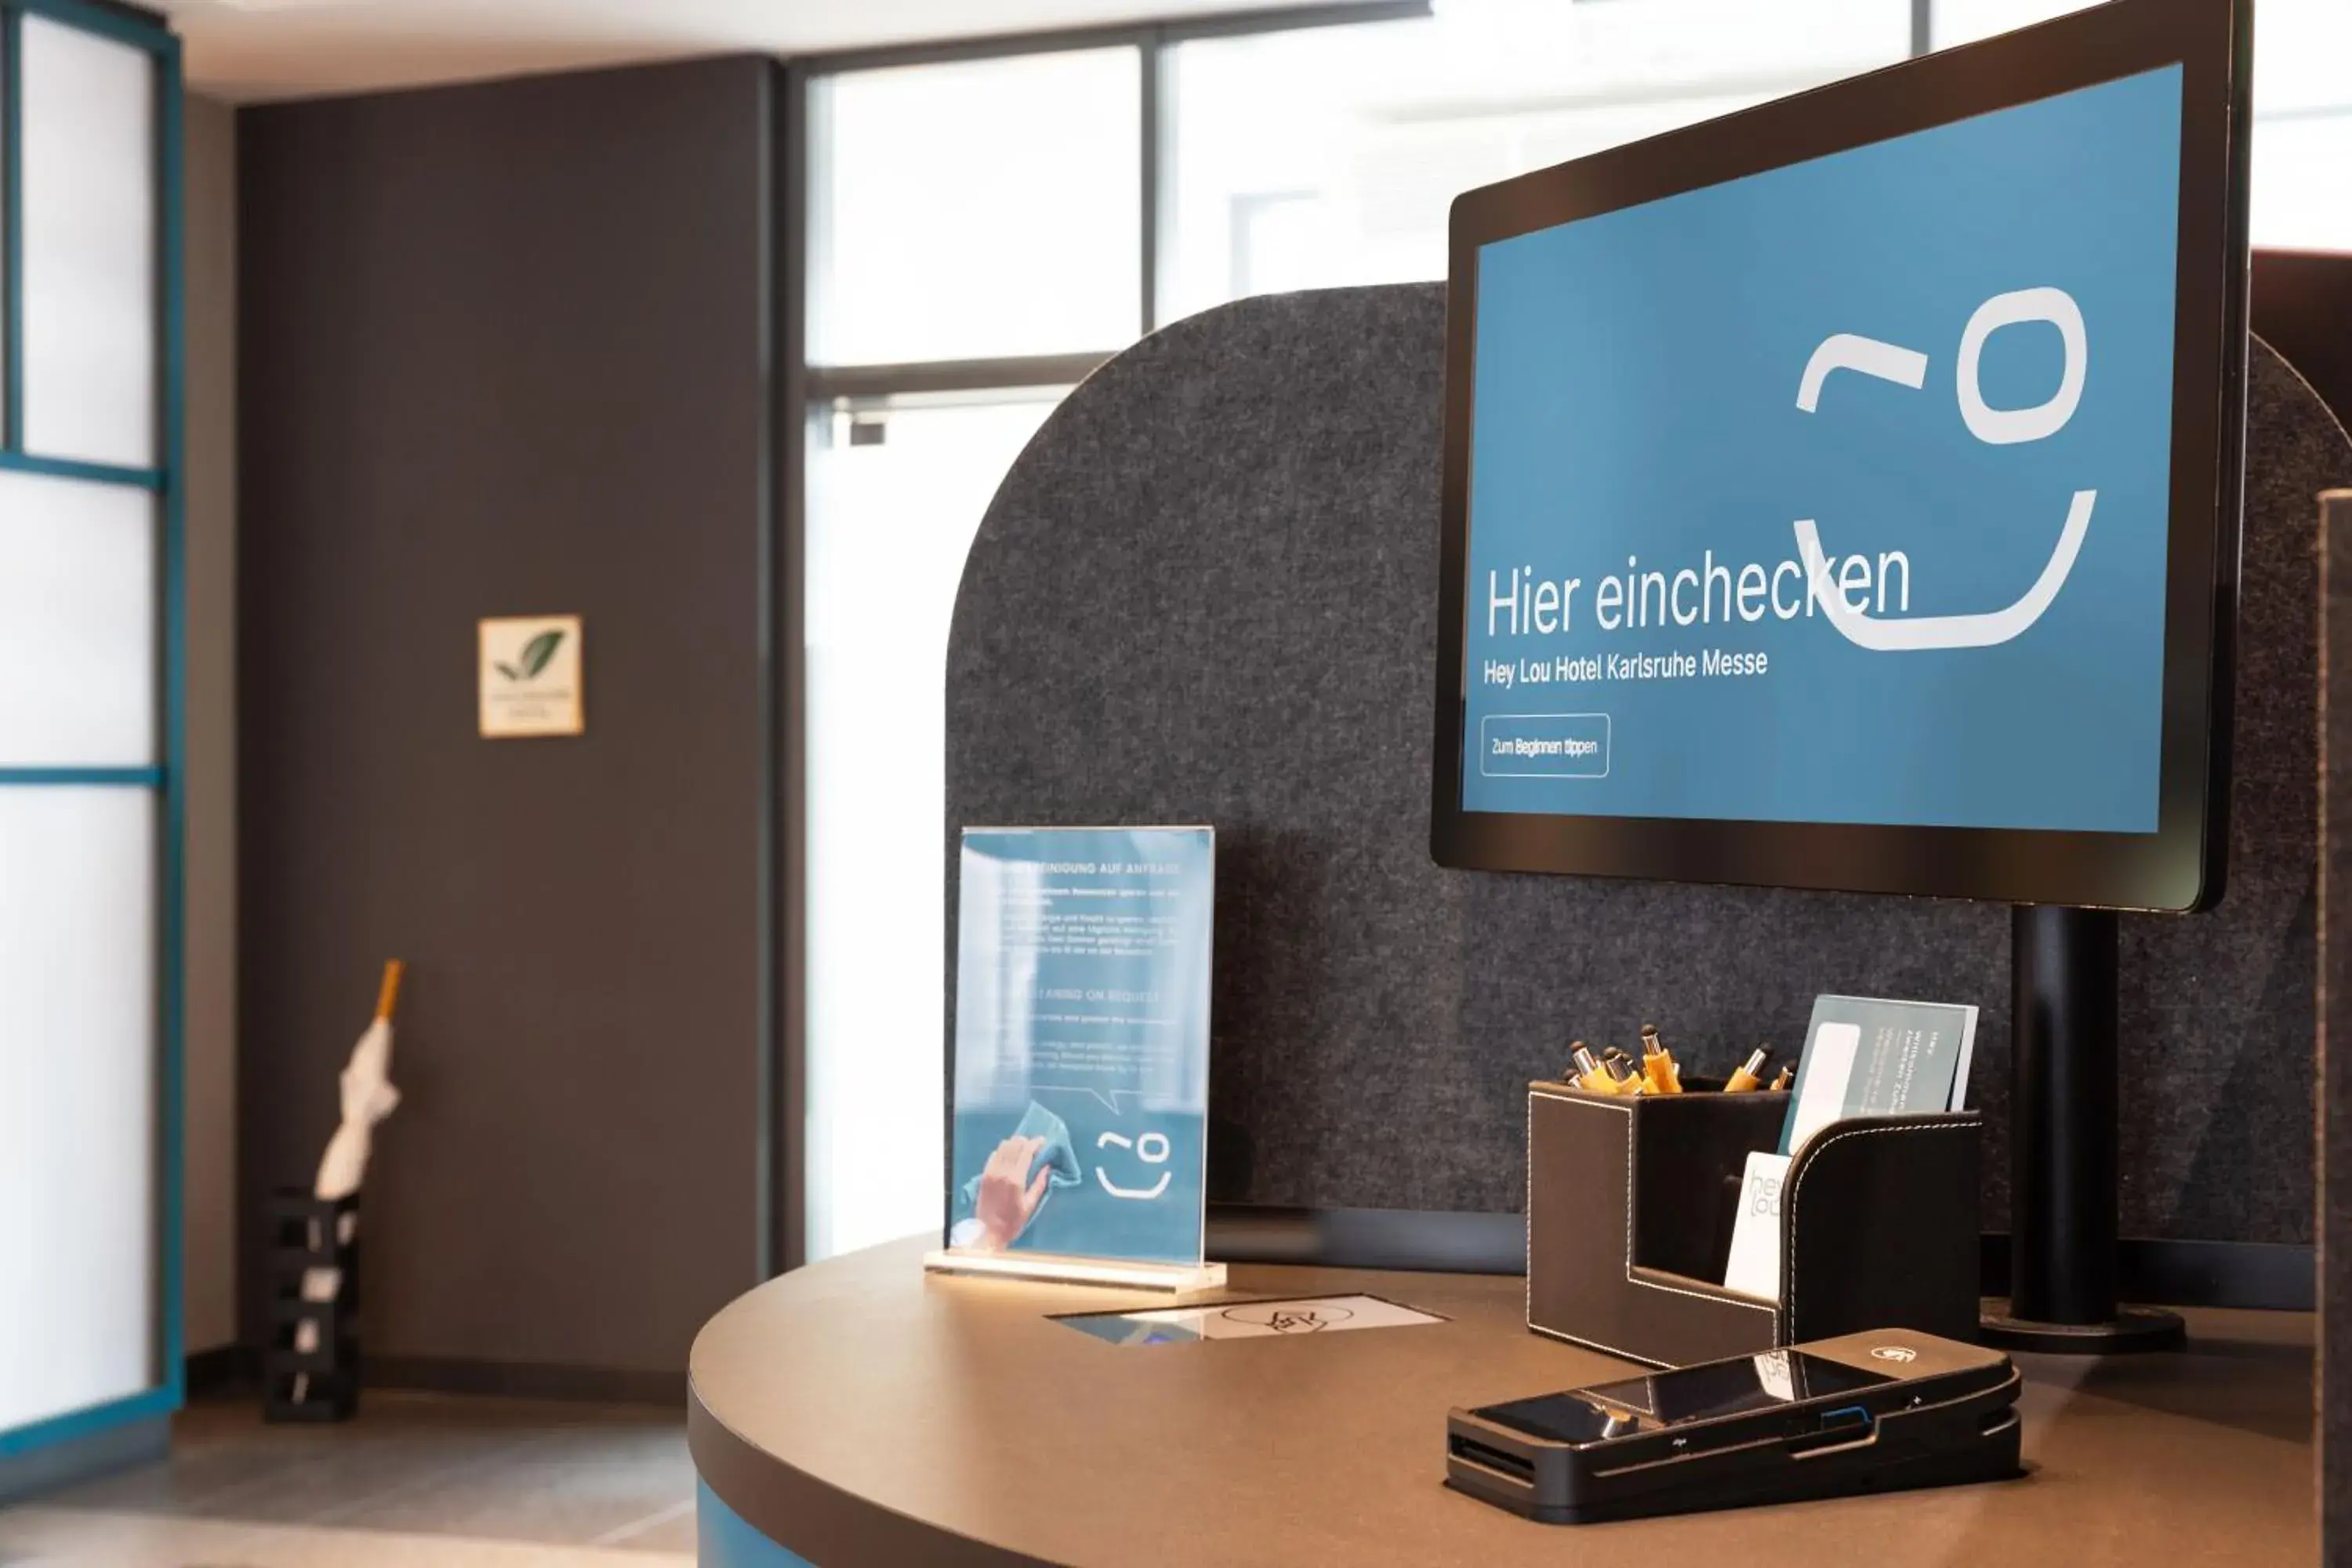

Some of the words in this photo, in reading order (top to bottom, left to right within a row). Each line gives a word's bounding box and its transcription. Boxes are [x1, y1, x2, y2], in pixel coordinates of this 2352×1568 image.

[1488, 564, 1581, 637] Hier
[1596, 540, 1910, 630] einchecken
[1484, 659, 1515, 689] Hey
[1519, 658, 1551, 683] Lou
[1555, 654, 1602, 682] Hotel
[1606, 649, 1697, 680] Karlsruhe
[1702, 648, 1768, 677] Messe
[1492, 738, 1513, 754] Zum
[1515, 737, 1562, 758] Beginnen
[1564, 737, 1598, 758] tippen
